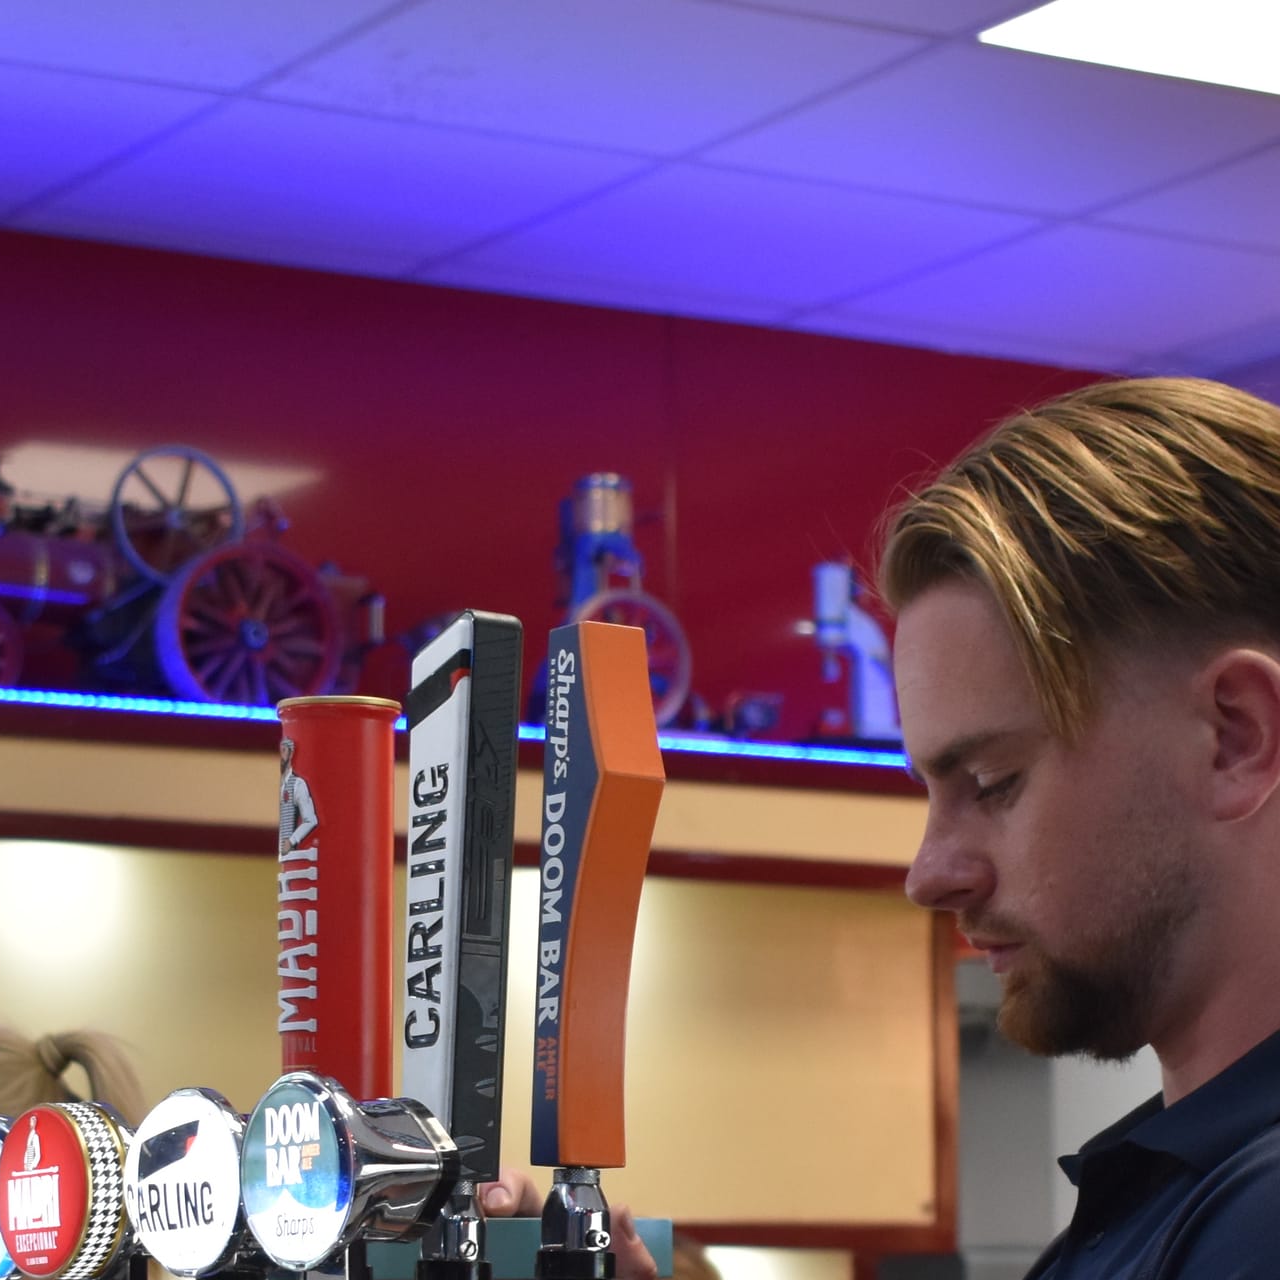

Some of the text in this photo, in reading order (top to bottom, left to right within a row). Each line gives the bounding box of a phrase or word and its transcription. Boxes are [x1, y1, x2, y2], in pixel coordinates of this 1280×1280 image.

[405, 762, 450, 1050] CARLING
[538, 791, 567, 1026] DOOM BAR
[265, 1101, 320, 1147] DOOM
[266, 1145, 303, 1187] BAR
[126, 1181, 214, 1233] CARLING
